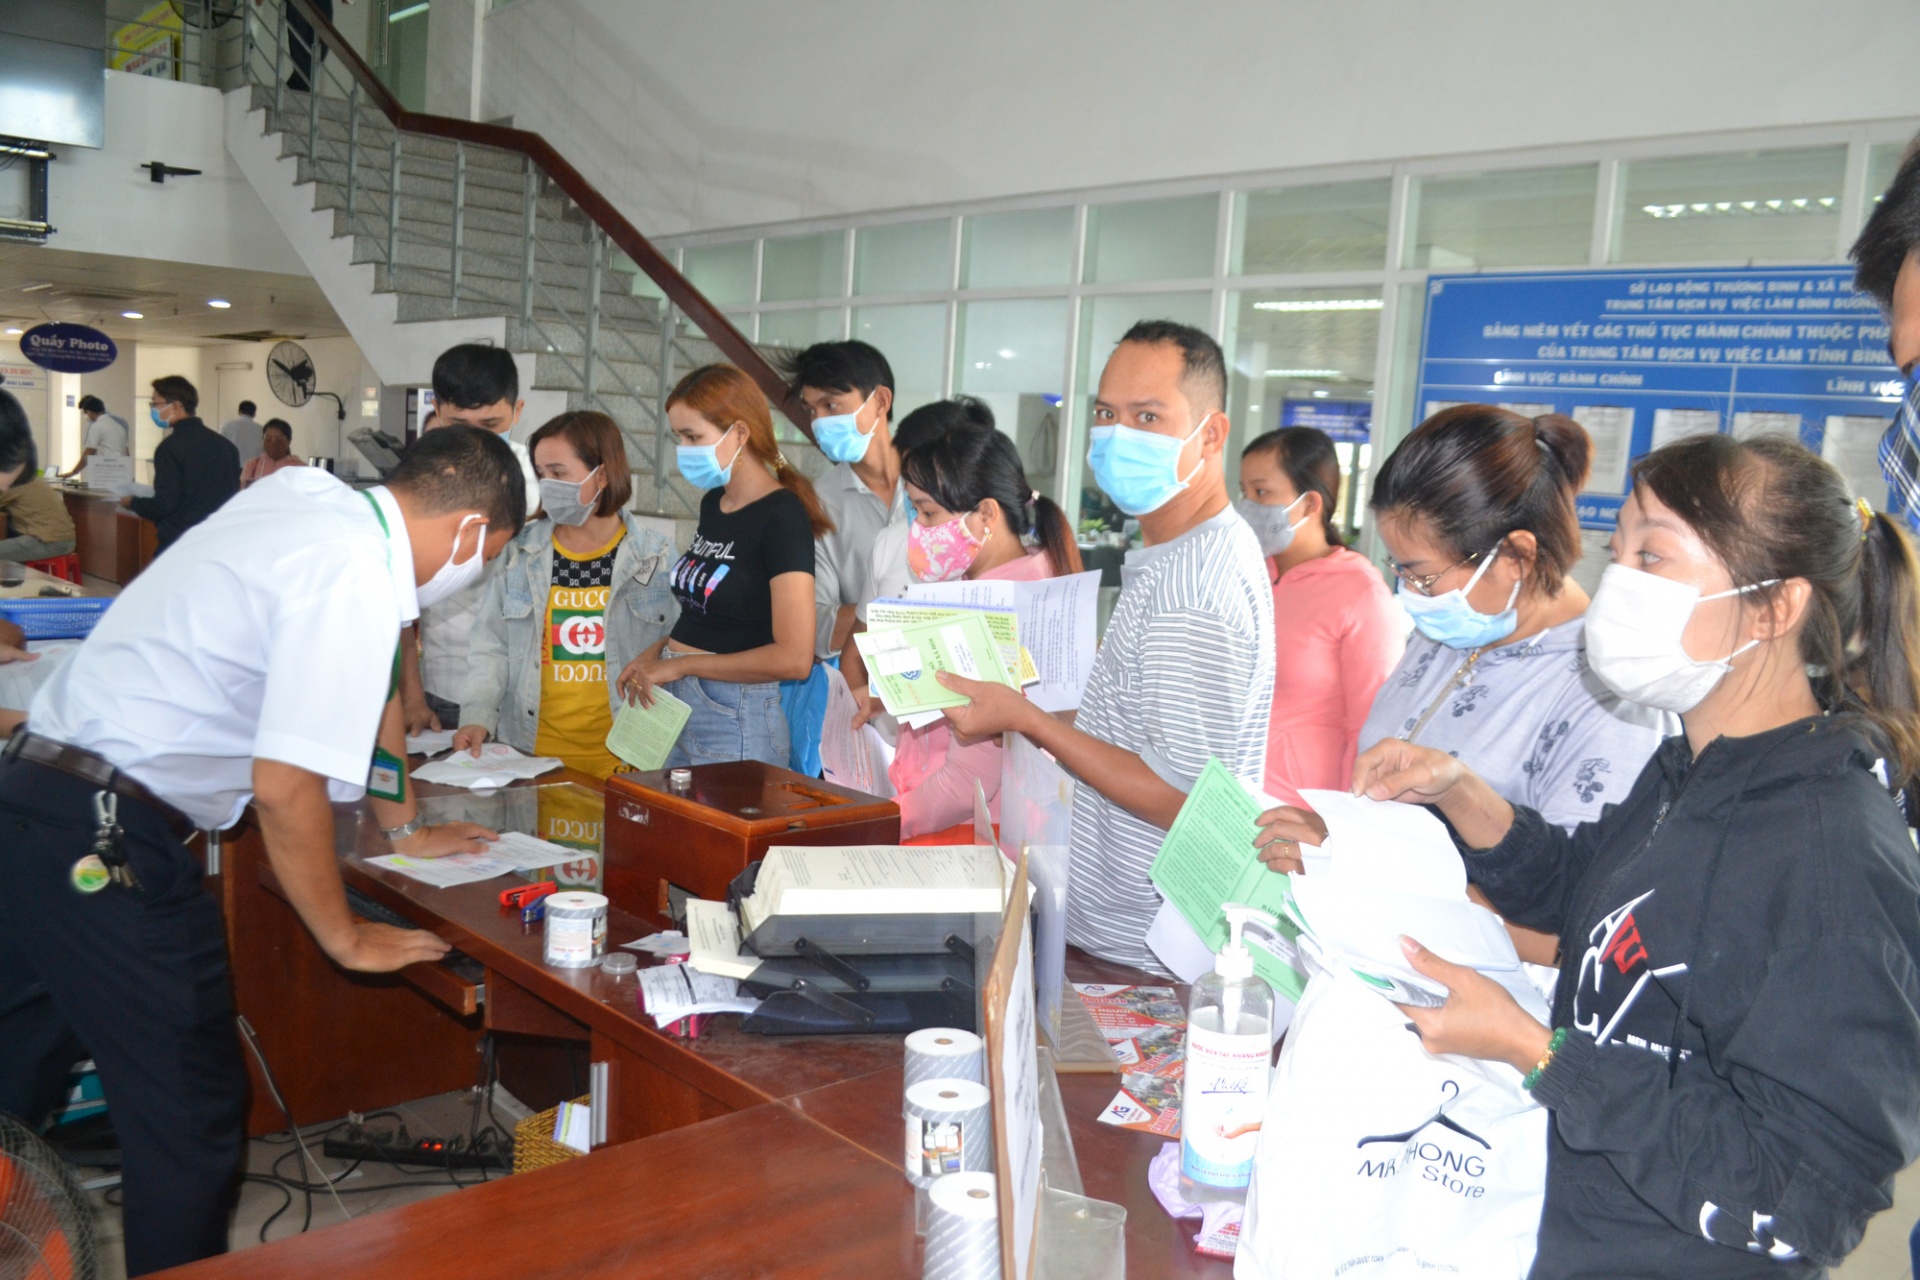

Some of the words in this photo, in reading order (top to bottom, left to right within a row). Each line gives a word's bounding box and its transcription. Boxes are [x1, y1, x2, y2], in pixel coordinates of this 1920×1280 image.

[30, 333, 65, 348] Quầy
[69, 337, 109, 352] Photo
[554, 589, 611, 608] GUCC
[553, 663, 608, 683] UCCI
[1406, 1142, 1486, 1178] HONG
[1422, 1165, 1486, 1199] Store
